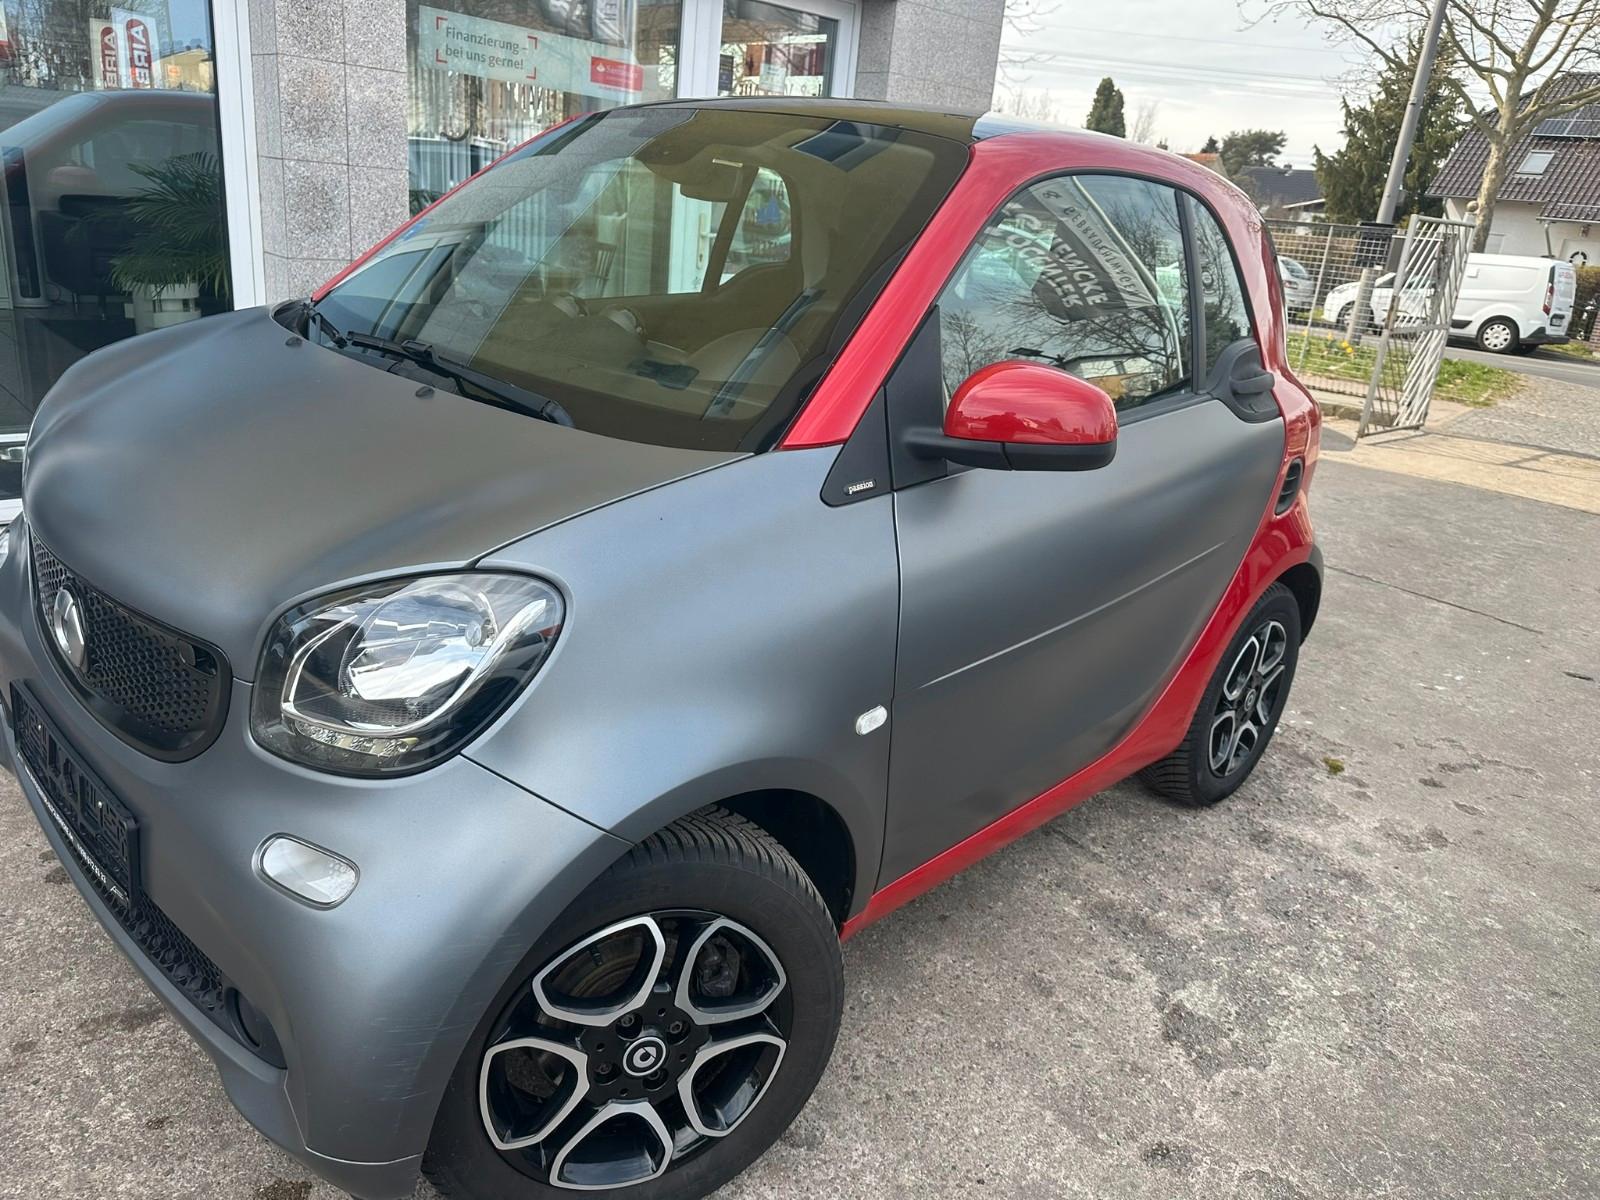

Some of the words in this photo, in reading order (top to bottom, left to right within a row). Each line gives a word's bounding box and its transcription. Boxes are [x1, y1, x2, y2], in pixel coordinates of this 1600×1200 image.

[445, 26, 519, 55] Finanzierung
[445, 44, 463, 58] bei
[466, 51, 486, 63] uns
[488, 55, 524, 70] gerne!
